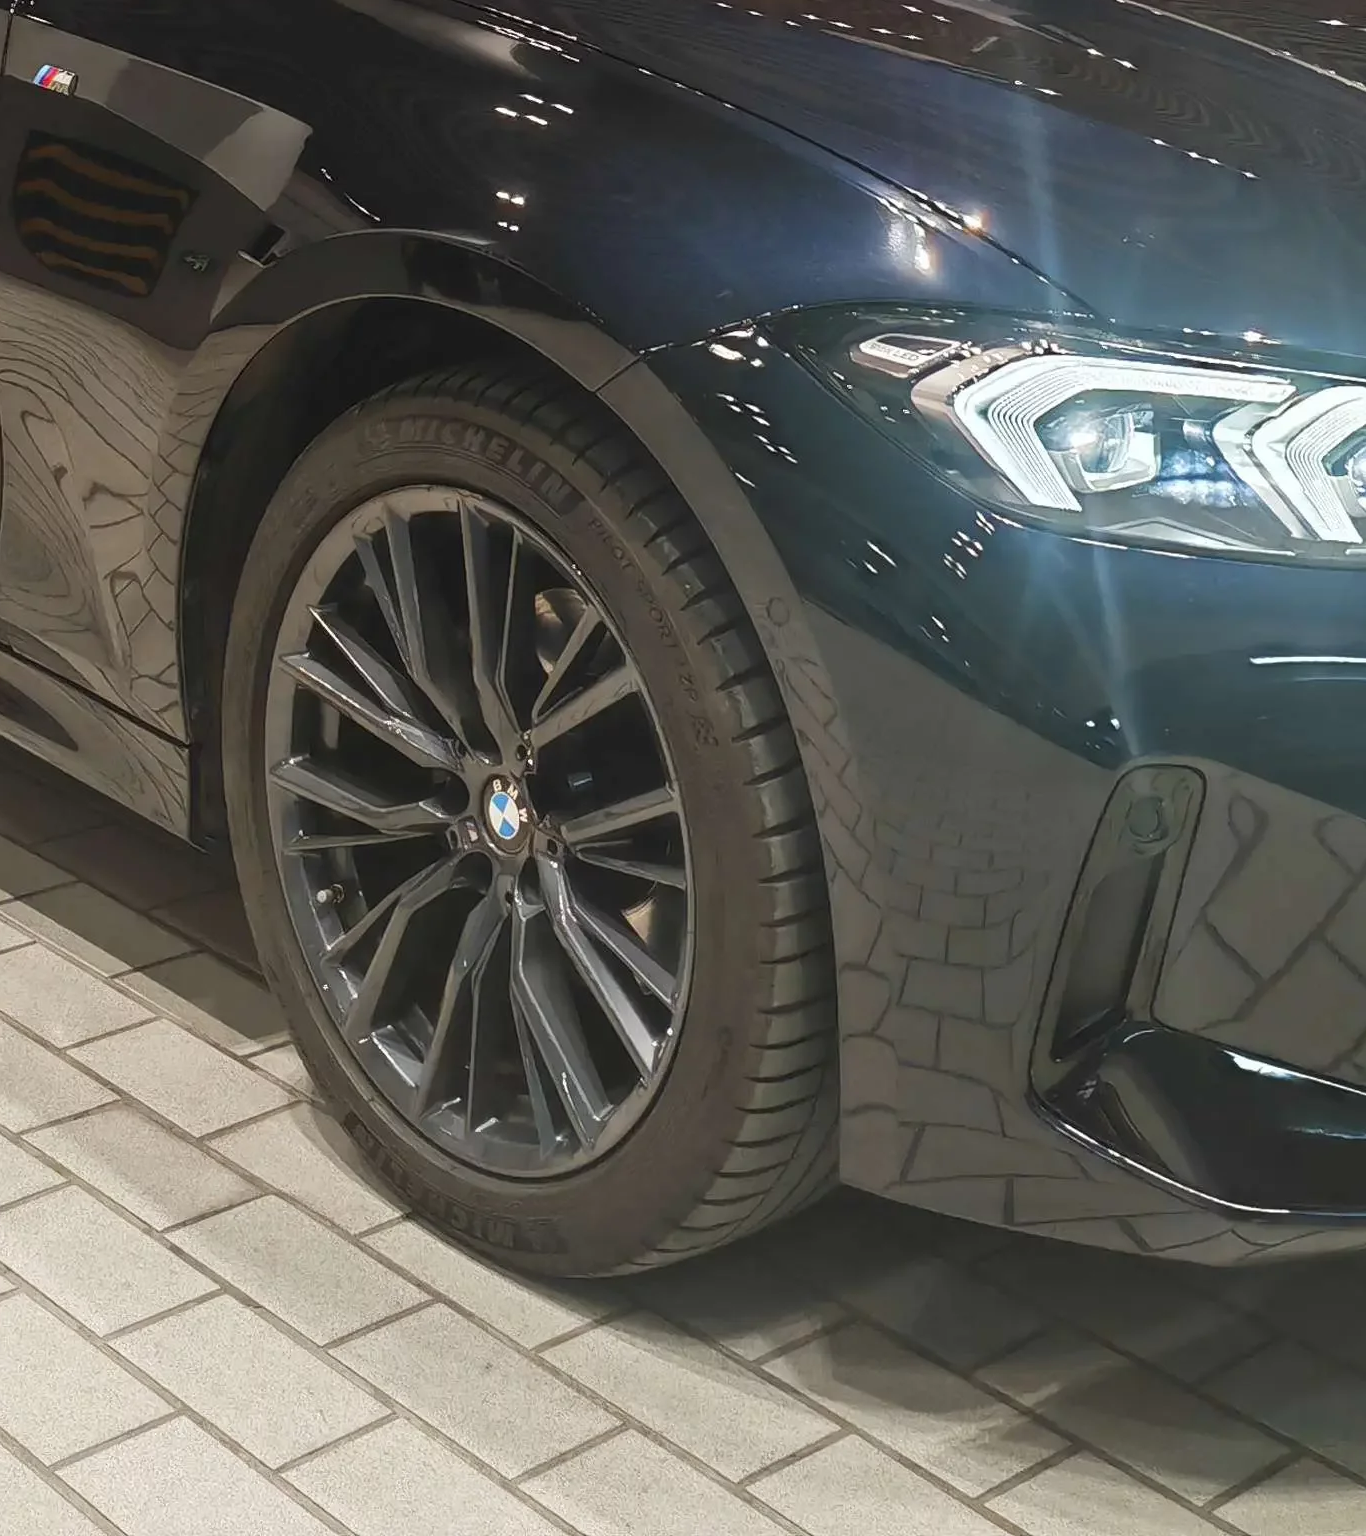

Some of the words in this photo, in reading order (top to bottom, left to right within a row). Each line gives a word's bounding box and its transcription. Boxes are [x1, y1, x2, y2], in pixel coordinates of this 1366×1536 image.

[398, 416, 574, 500] MICHELIN
[587, 517, 634, 571] PILOT
[492, 778, 528, 823] BMW
